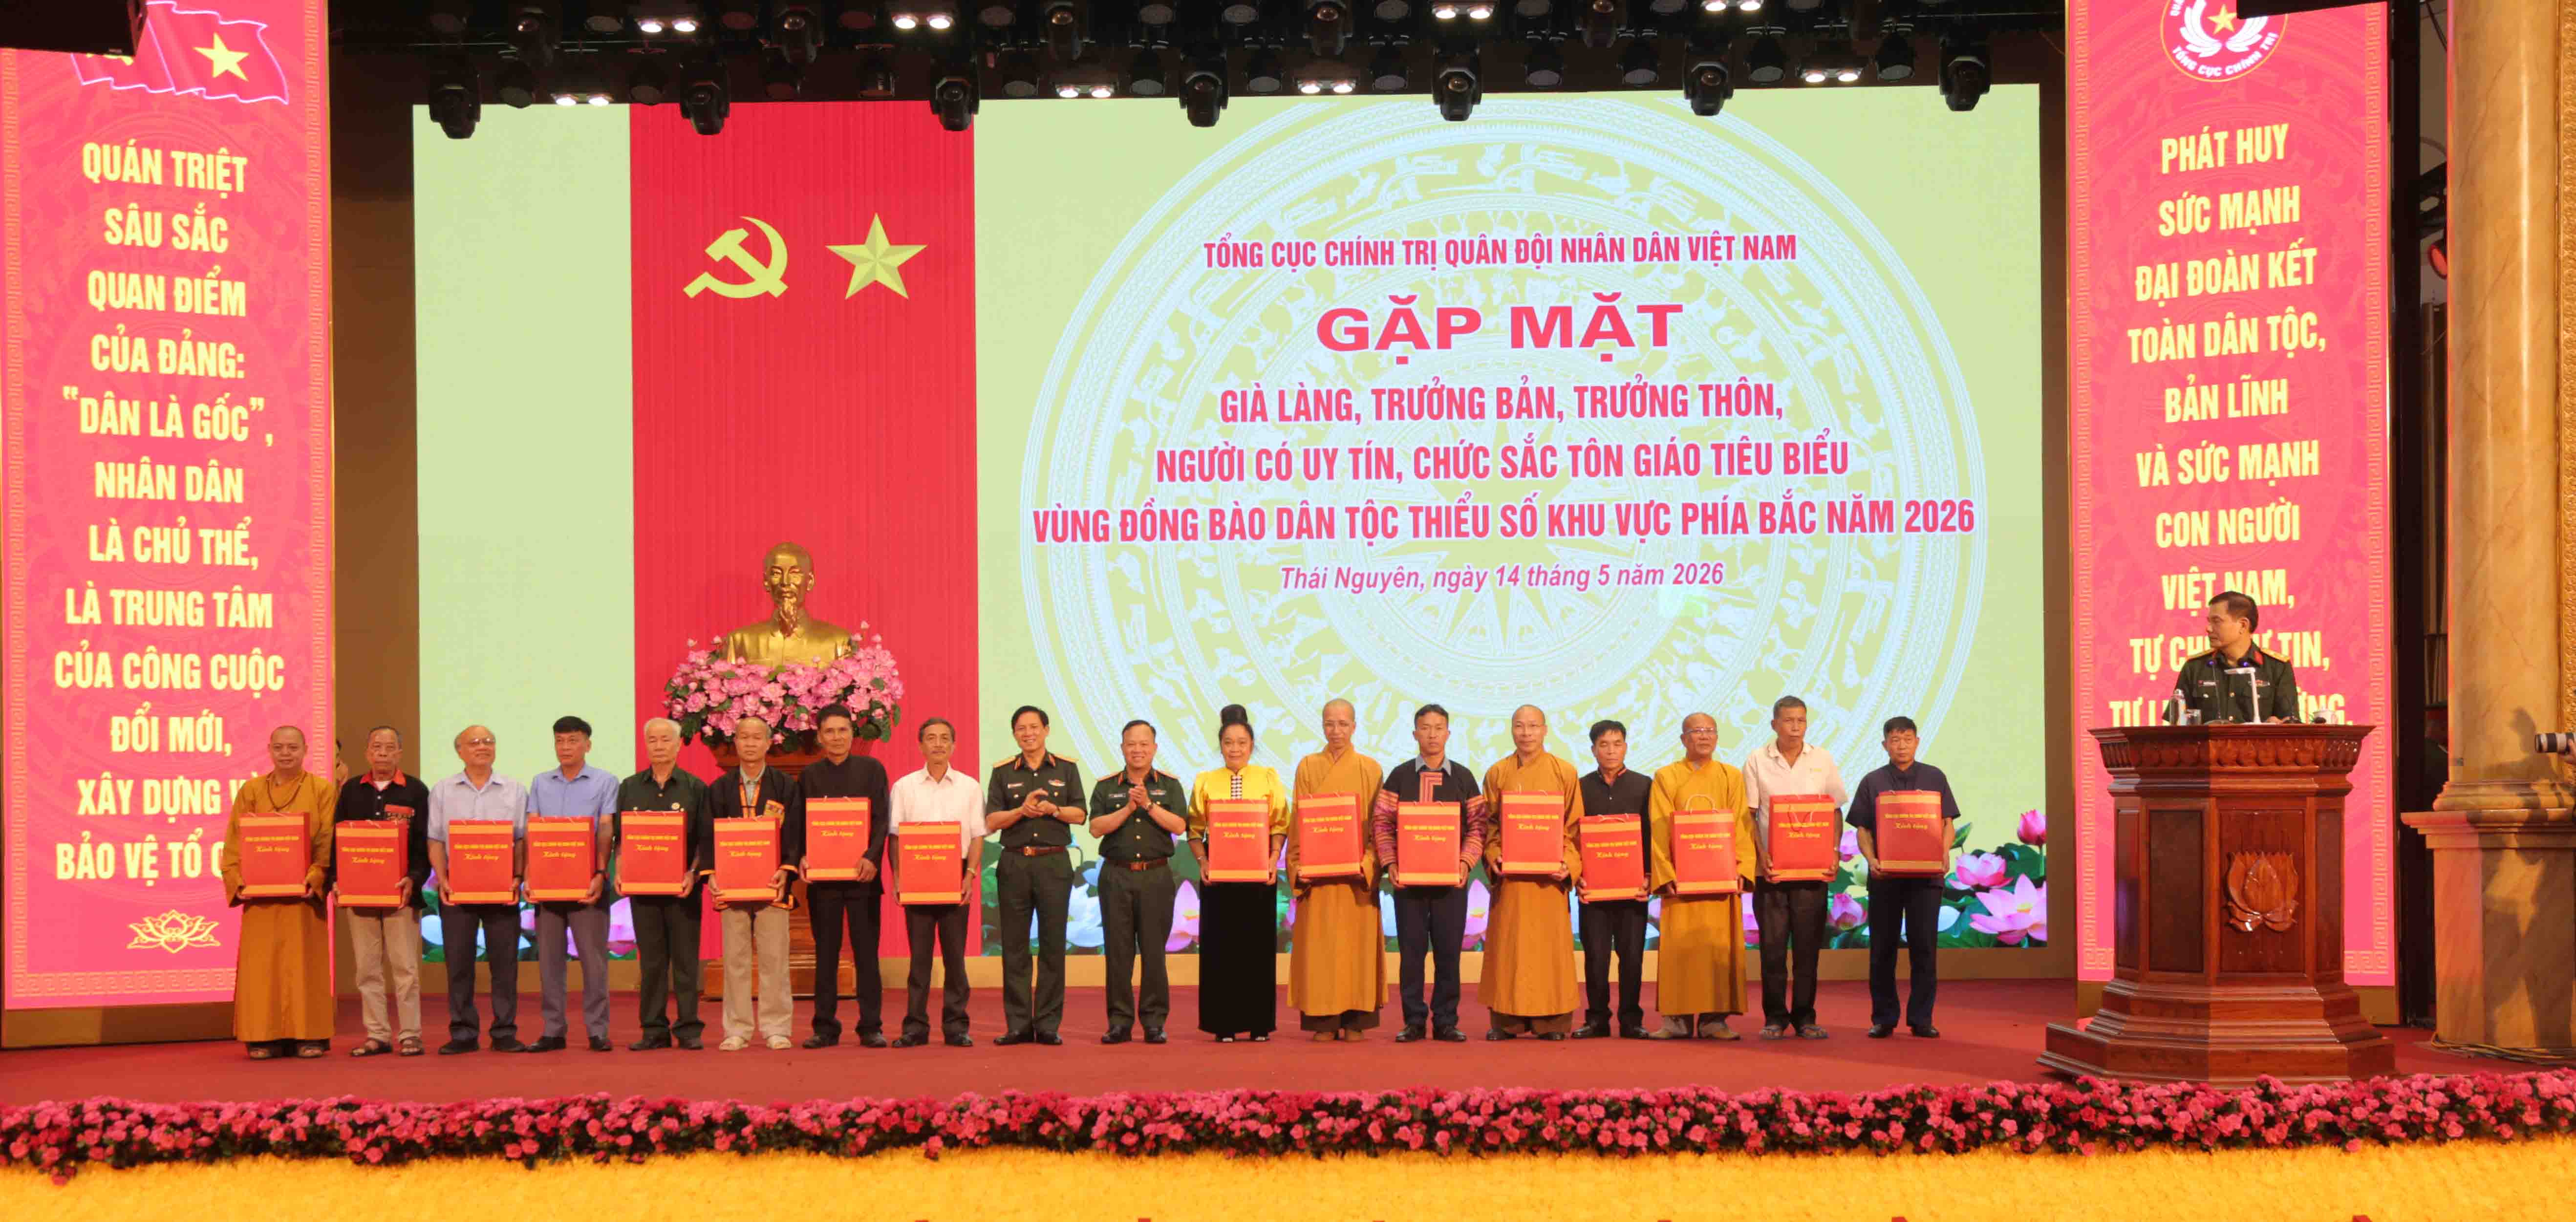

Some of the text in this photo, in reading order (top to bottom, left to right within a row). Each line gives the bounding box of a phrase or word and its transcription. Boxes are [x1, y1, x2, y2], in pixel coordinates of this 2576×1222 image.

[2173, 32, 2279, 77] TỔNG CỤC CHÍNH TRỊ
[82, 138, 249, 199] QUÁN TRIỆT
[2161, 123, 2289, 174] PHÁT HUY
[103, 201, 229, 254] SÂU SẮC
[2158, 185, 2300, 237] SỨC MẠNH
[1203, 230, 1797, 273] TỔNG CỤC CHÍNH TRỊ QUÂN ĐỘI NHÂN DÂN VIỆT NAM
[2134, 236, 2318, 308] ĐẠI ĐOÀN KẾT
[87, 264, 247, 318] QUAN ĐIỂM
[90, 322, 245, 379] CỦA ĐẢNG:
[1316, 291, 1684, 365] GẶP MẶT
[2126, 305, 2327, 364] TOÀN DÂN TỘC,
[149, 394, 185, 439] LÀ
[1220, 373, 1783, 426] GIÀ LÀNG, TRƯỞNG BẢN, TRƯỞNG THÔN,
[2165, 373, 2289, 423] BẢN LĨNH
[94, 455, 244, 504] NHÂN DÂN
[1156, 427, 1848, 484] NGƯỜI CÓ UY TÍN, CHỨC SẮC TÔN GIÁO TIÊU BIỂU
[2135, 439, 2320, 488] VÀ SỨC MẠNH
[88, 515, 259, 571] LÀ CHỦ THỂ,
[1032, 488, 1975, 547] VÙNG ĐỒNG BÀO DÂN TỘC THIỂU SỐ KHU VỰC PHÍA BẮC NĂM 2026
[2155, 495, 2301, 549] CON NGƯỜI
[65, 579, 274, 629] LÀ TRUNG TÂM
[1281, 562, 1724, 595] Thái Nguyên, ngày 14 tháng 5 năm 2026
[2161, 565, 2296, 617] VIỆT NAM,
[54, 639, 285, 699] CỦA CÔNG CUỘC
[2128, 633, 2165, 681] TỰ
[2168, 635, 2211, 673] CH
[109, 701, 233, 757] ĐỔI MỚI,
[77, 771, 134, 816] XÂY
[142, 774, 222, 824] DỰNG
[55, 830, 116, 880] BẢO
[123, 833, 160, 887] VỆ
[166, 827, 204, 879] TỔ
